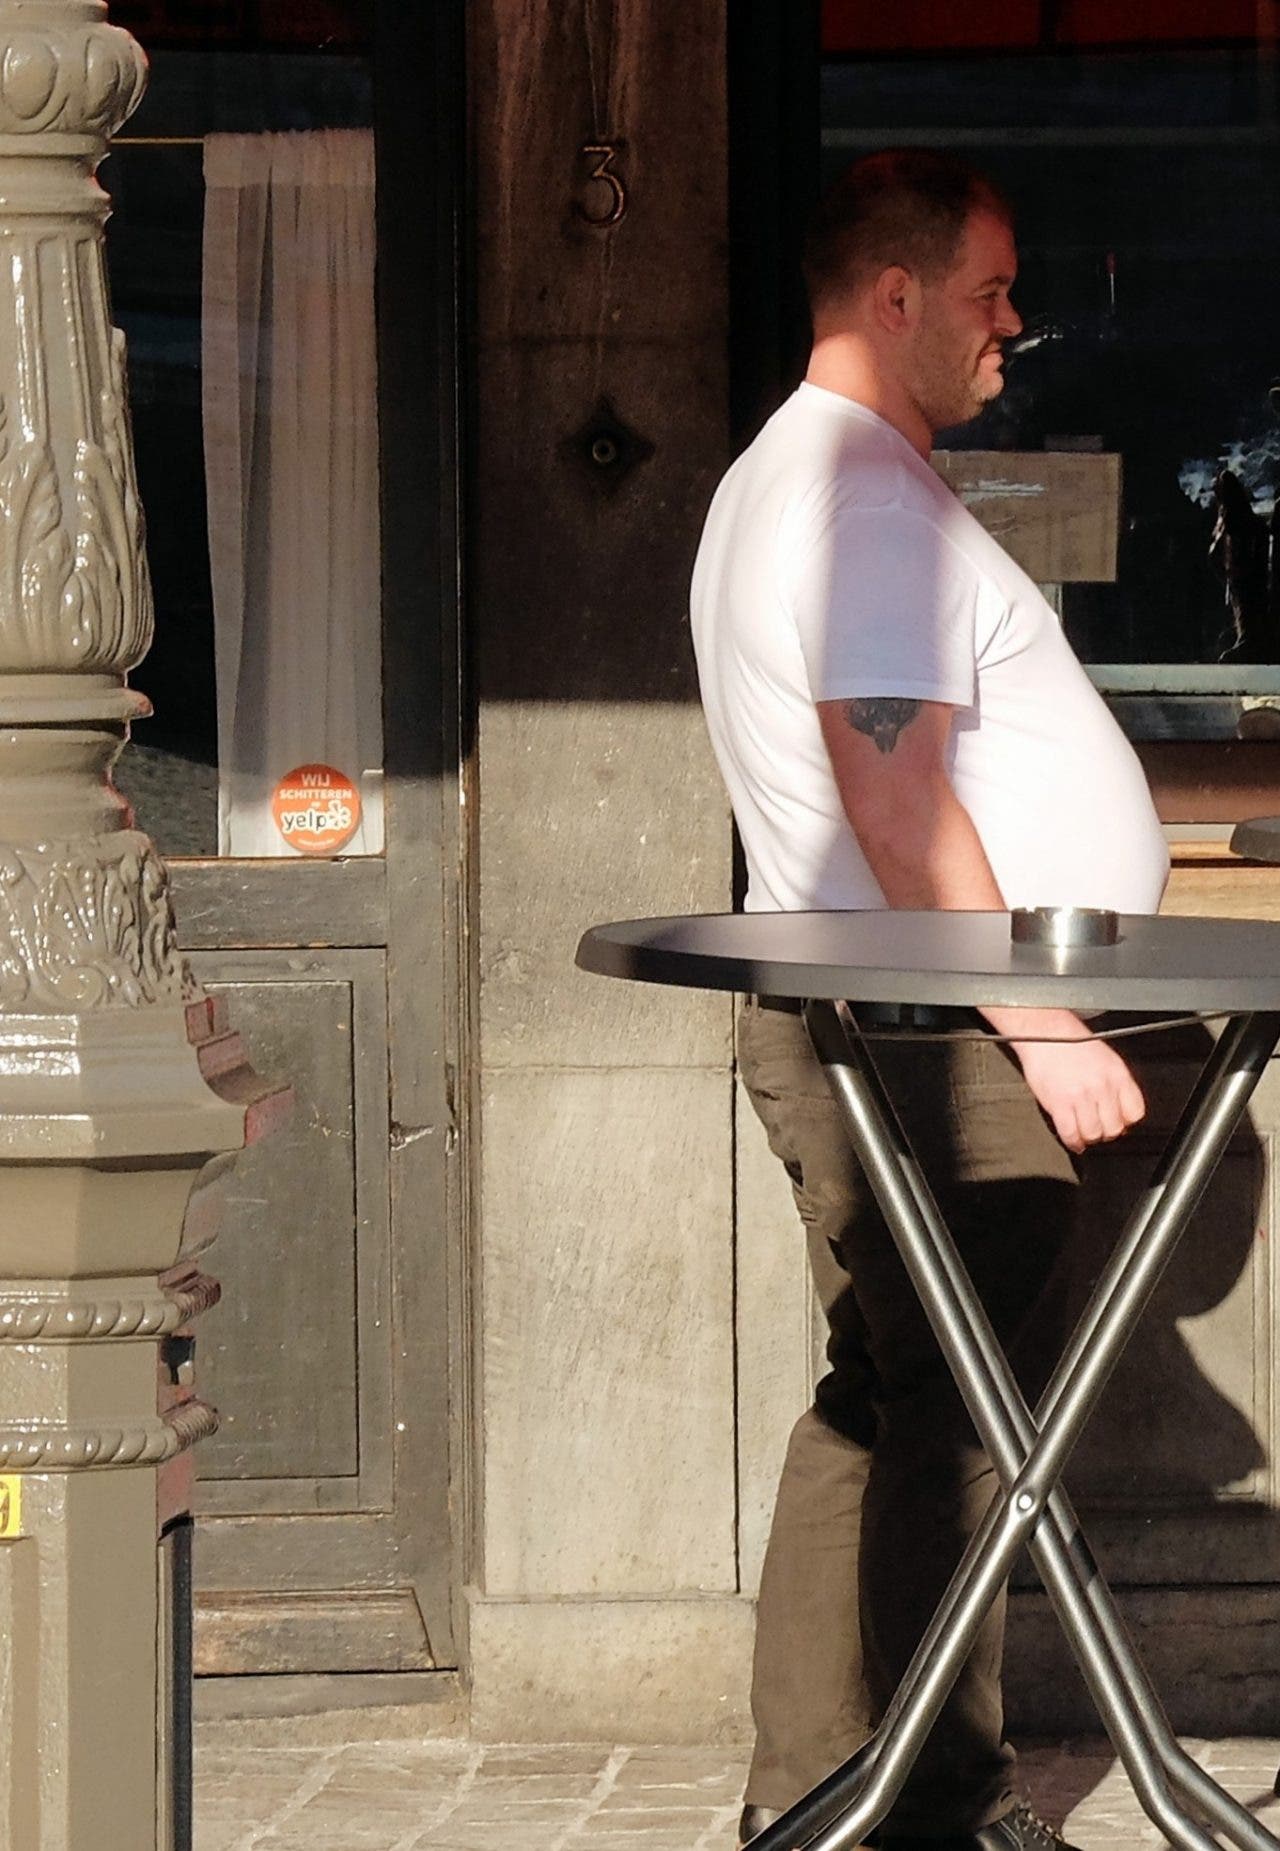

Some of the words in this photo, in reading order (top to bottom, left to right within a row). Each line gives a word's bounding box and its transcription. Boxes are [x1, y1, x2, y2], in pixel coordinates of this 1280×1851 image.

[579, 146, 625, 223] 3
[301, 773, 331, 787] WIJ
[279, 788, 353, 800] SCHITTEREN
[283, 810, 328, 832] yelp
